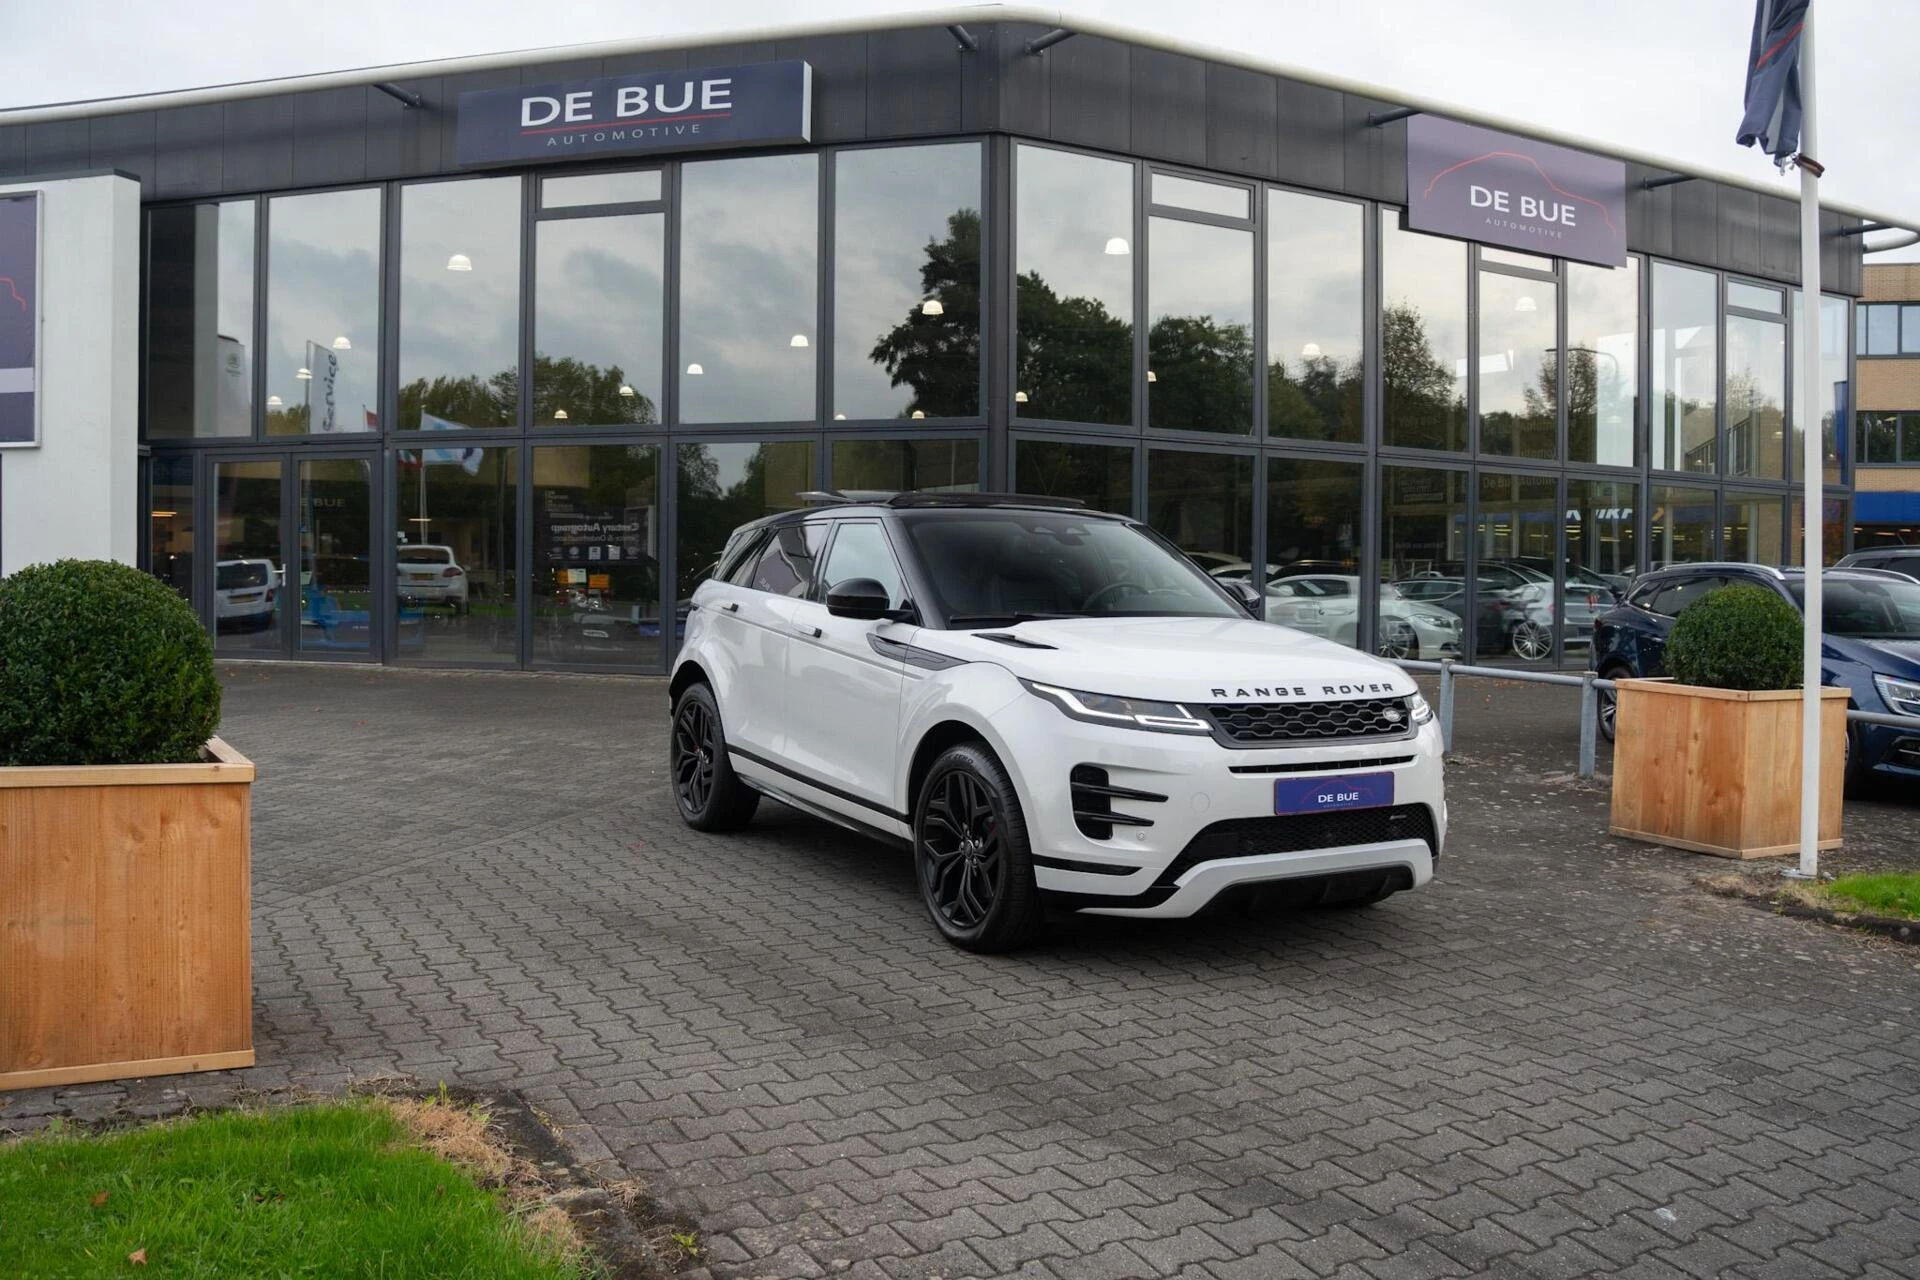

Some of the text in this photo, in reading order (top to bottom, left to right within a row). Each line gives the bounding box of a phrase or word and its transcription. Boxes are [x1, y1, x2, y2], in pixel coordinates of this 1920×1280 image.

[521, 78, 732, 127] DE BUE
[547, 124, 701, 146] AUTOMOTIVE
[1470, 185, 1576, 227] DE BUE
[1485, 218, 1562, 239] AUTOMOTIVE
[1211, 683, 1394, 698] RANGE ROVER
[1318, 791, 1360, 803] DE BUE
